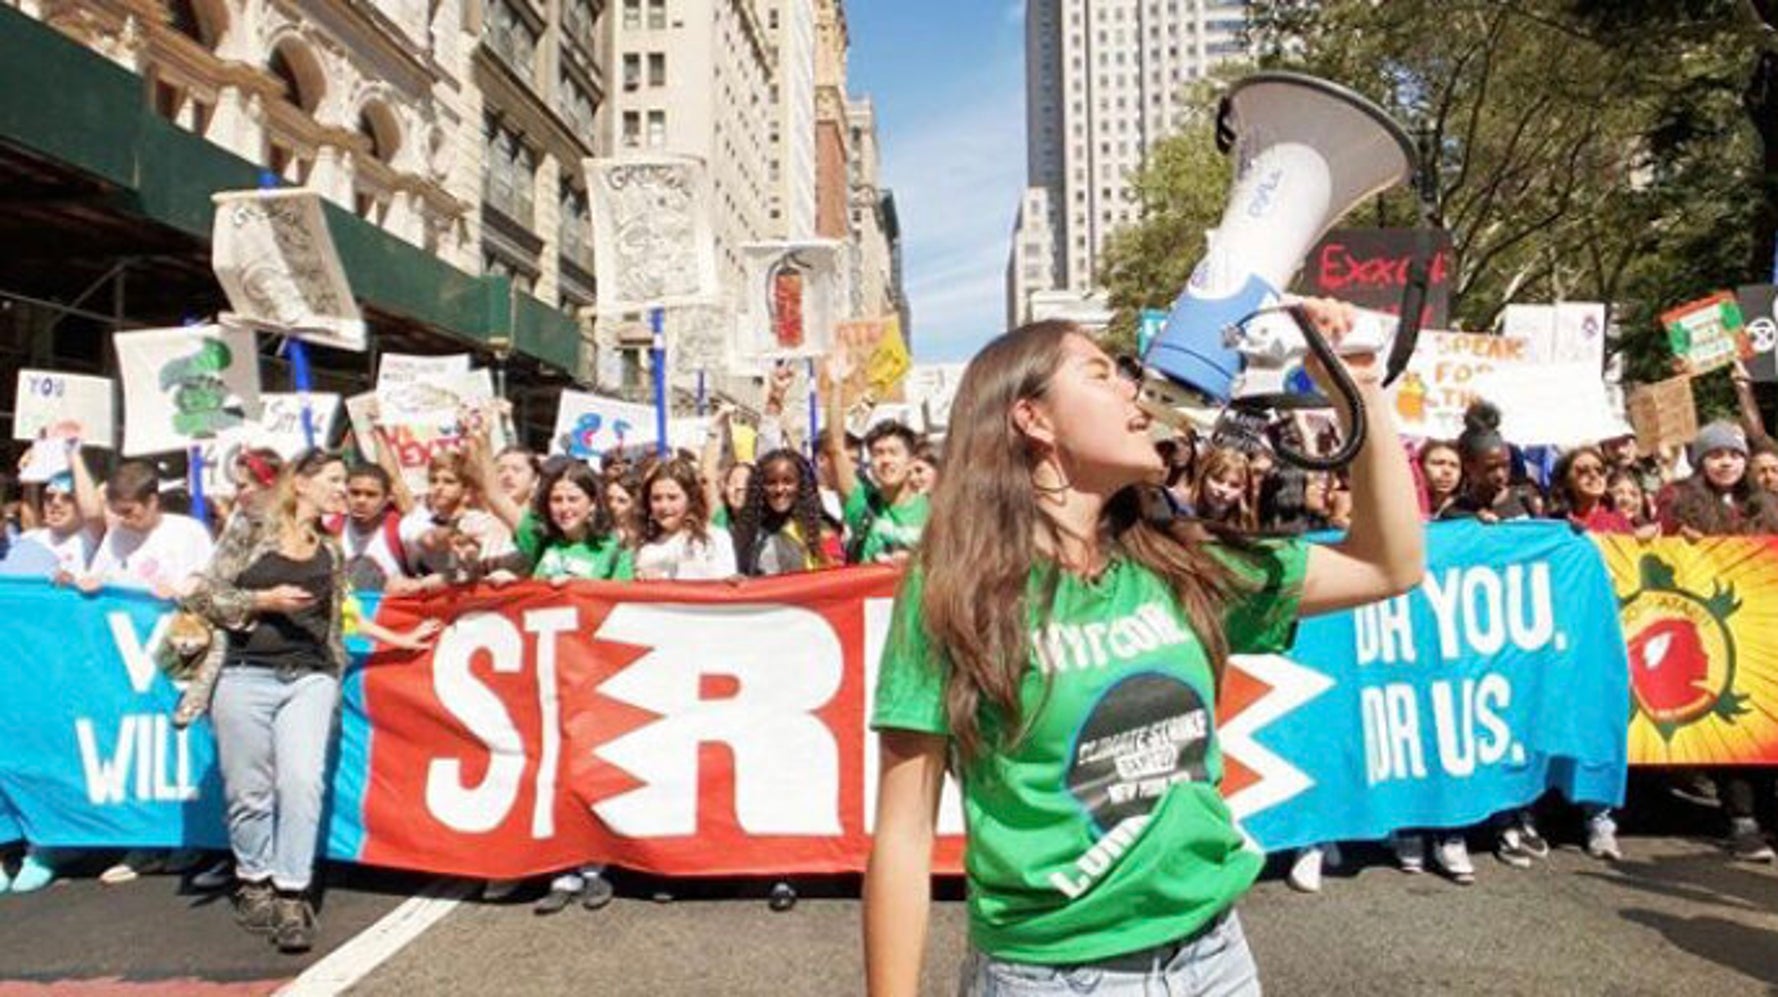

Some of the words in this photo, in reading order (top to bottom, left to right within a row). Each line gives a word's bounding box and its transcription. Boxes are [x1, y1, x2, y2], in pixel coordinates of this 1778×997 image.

[1422, 560, 1568, 662] YOU.
[75, 713, 199, 806] WILL
[1431, 672, 1525, 778] US.
